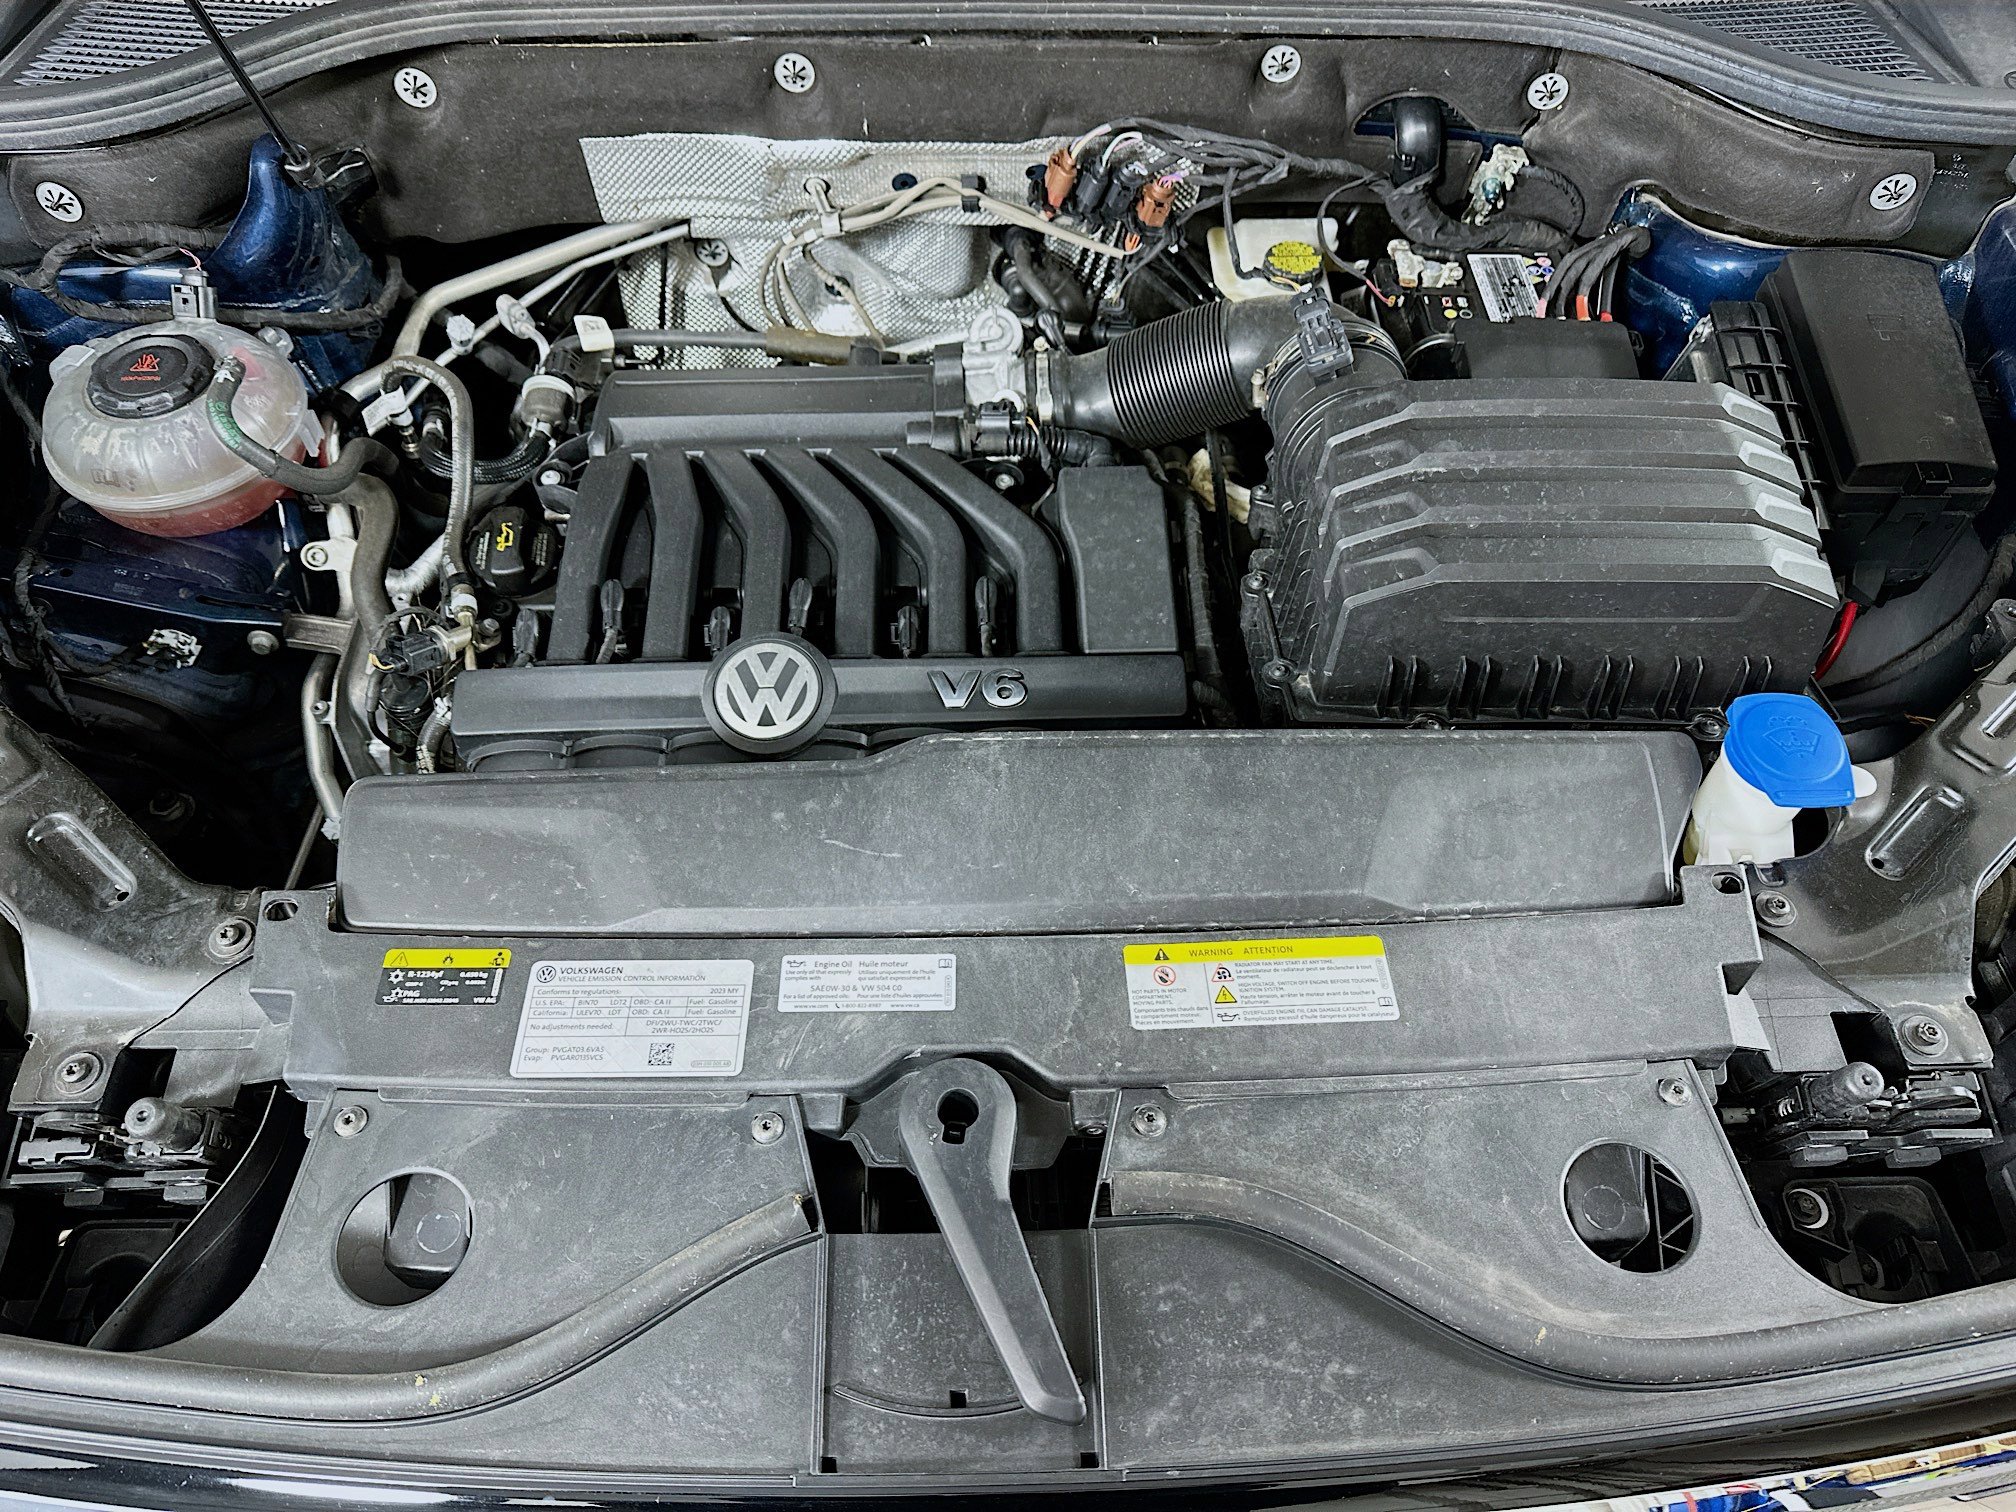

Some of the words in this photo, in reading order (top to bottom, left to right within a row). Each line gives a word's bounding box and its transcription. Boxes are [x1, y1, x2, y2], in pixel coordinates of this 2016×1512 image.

[927, 667, 1029, 709] V6
[1189, 948, 1233, 957] WARNING
[1243, 946, 1293, 955] ATTENTION
[814, 961, 840, 969] Engine
[560, 967, 624, 975] VOLKSWAGEN
[581, 988, 622, 997] regulations:
[541, 1023, 585, 1031] adjustments
[523, 1054, 543, 1062] Evap:
